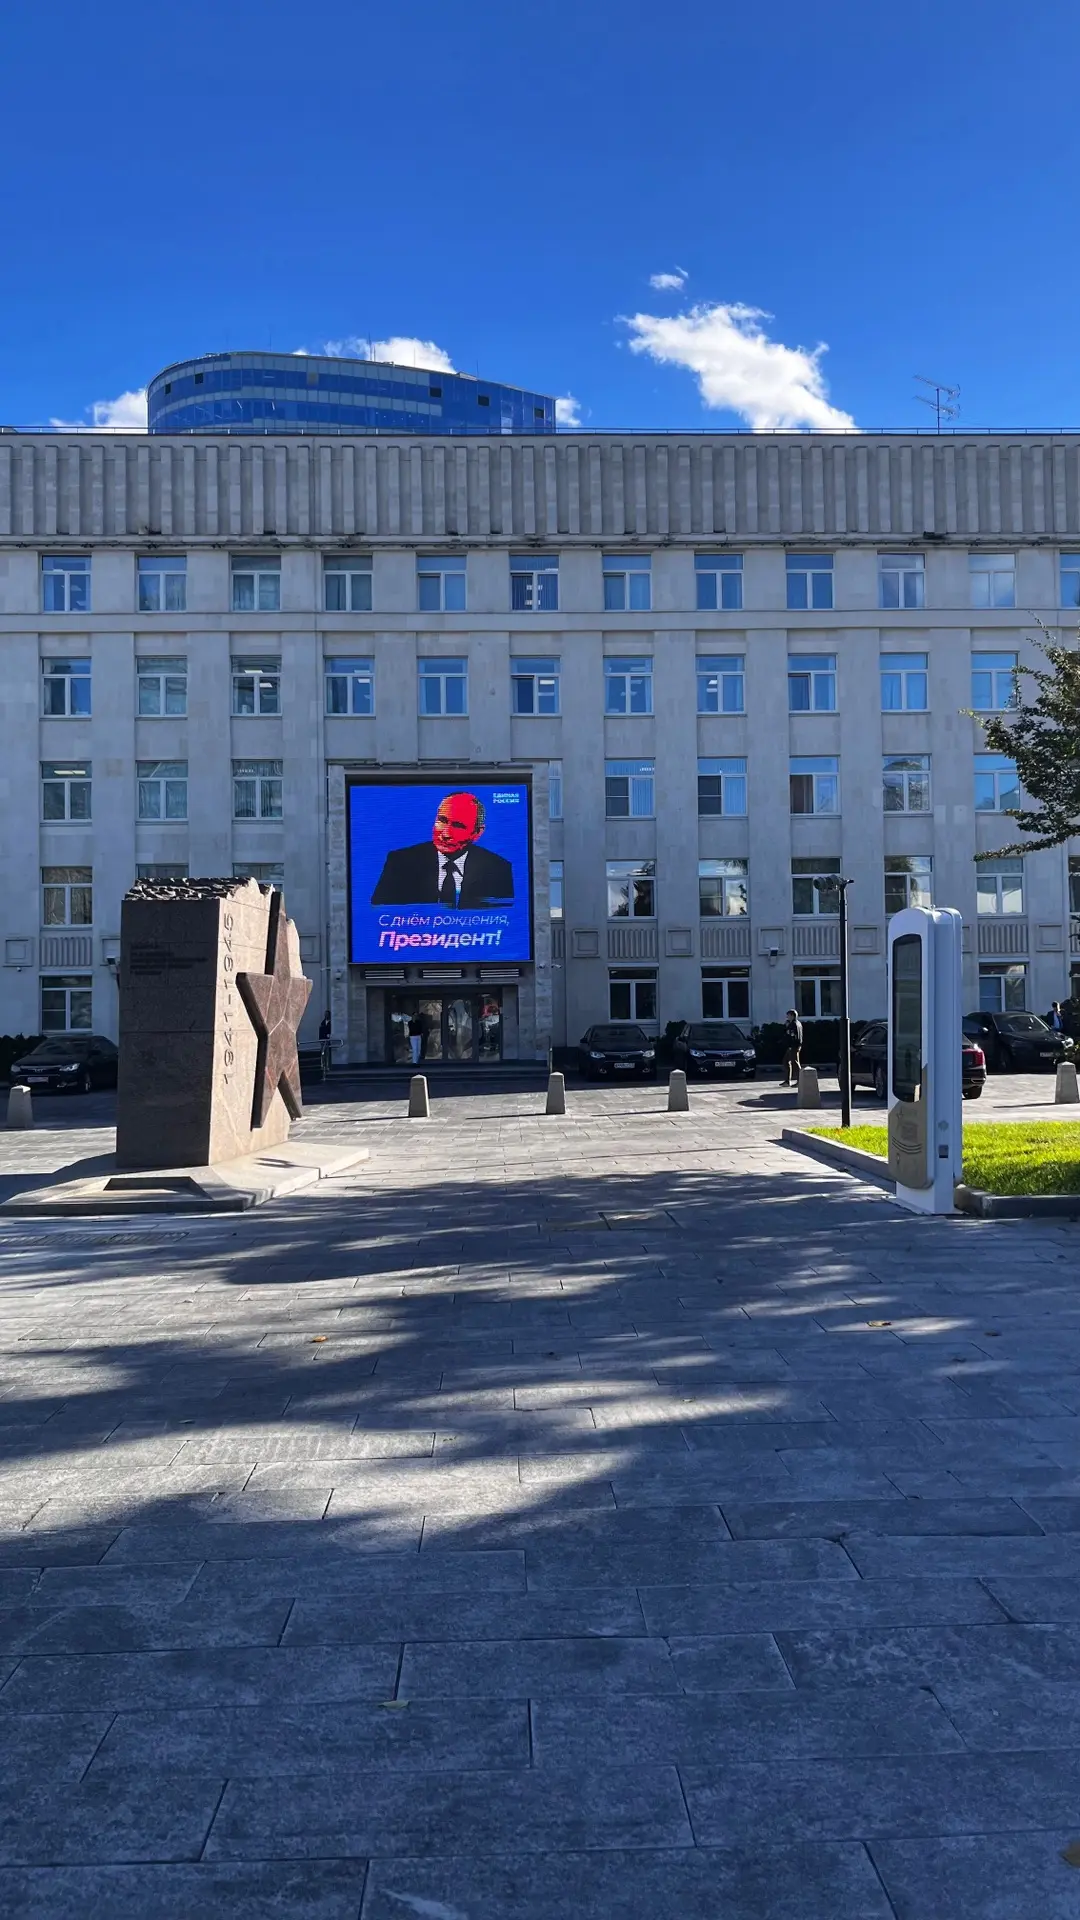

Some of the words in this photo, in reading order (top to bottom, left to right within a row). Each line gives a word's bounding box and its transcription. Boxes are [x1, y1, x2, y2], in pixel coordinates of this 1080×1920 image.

[378, 914, 390, 927] С
[390, 913, 430, 928] днём
[432, 914, 510, 928] рождения,
[378, 929, 502, 951] Президент!
[223, 912, 234, 1085] 1941-1945
